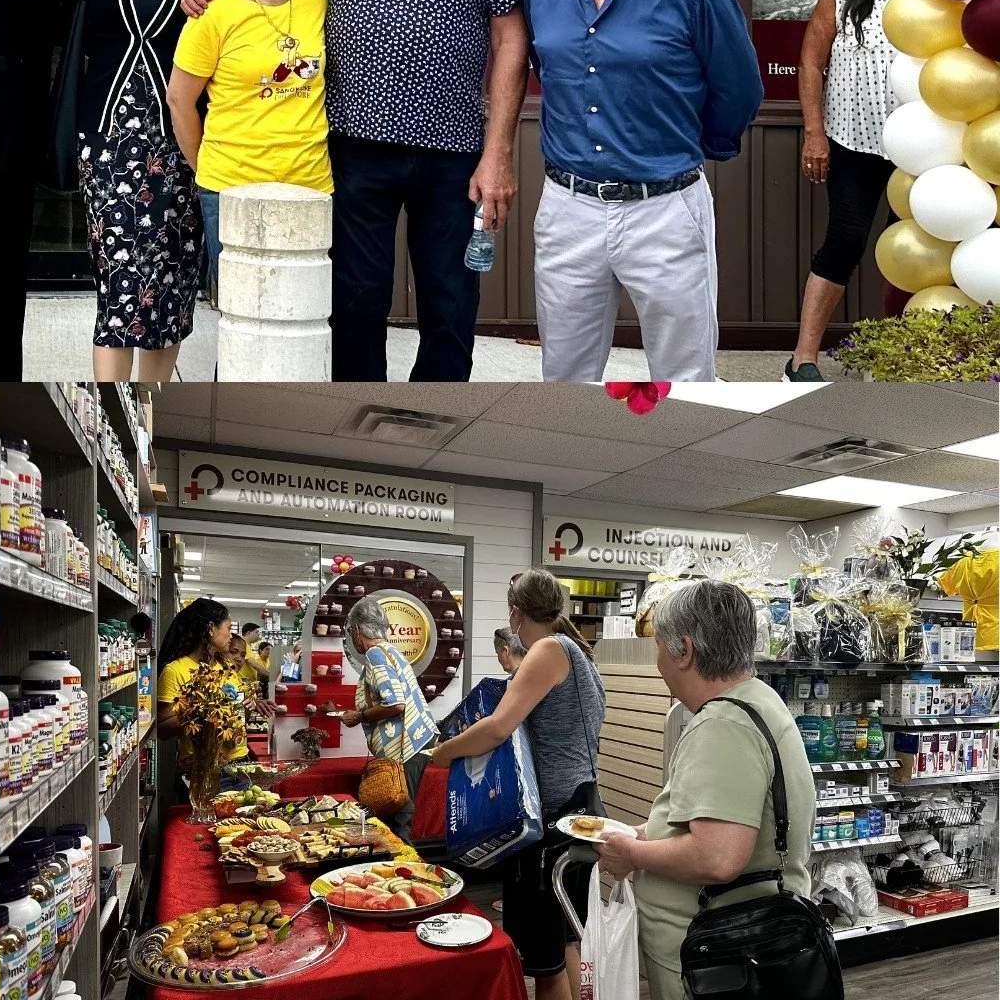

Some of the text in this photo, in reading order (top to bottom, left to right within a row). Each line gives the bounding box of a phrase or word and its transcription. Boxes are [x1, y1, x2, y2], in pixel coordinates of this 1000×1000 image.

[767, 62, 797, 75] Here
[231, 468, 448, 506] COMPLIANCE PACKAGING
[237, 488, 442, 523] AND AUTOMATION ROOM
[605, 528, 732, 553] INJECTION AND
[389, 623, 422, 636] Year
